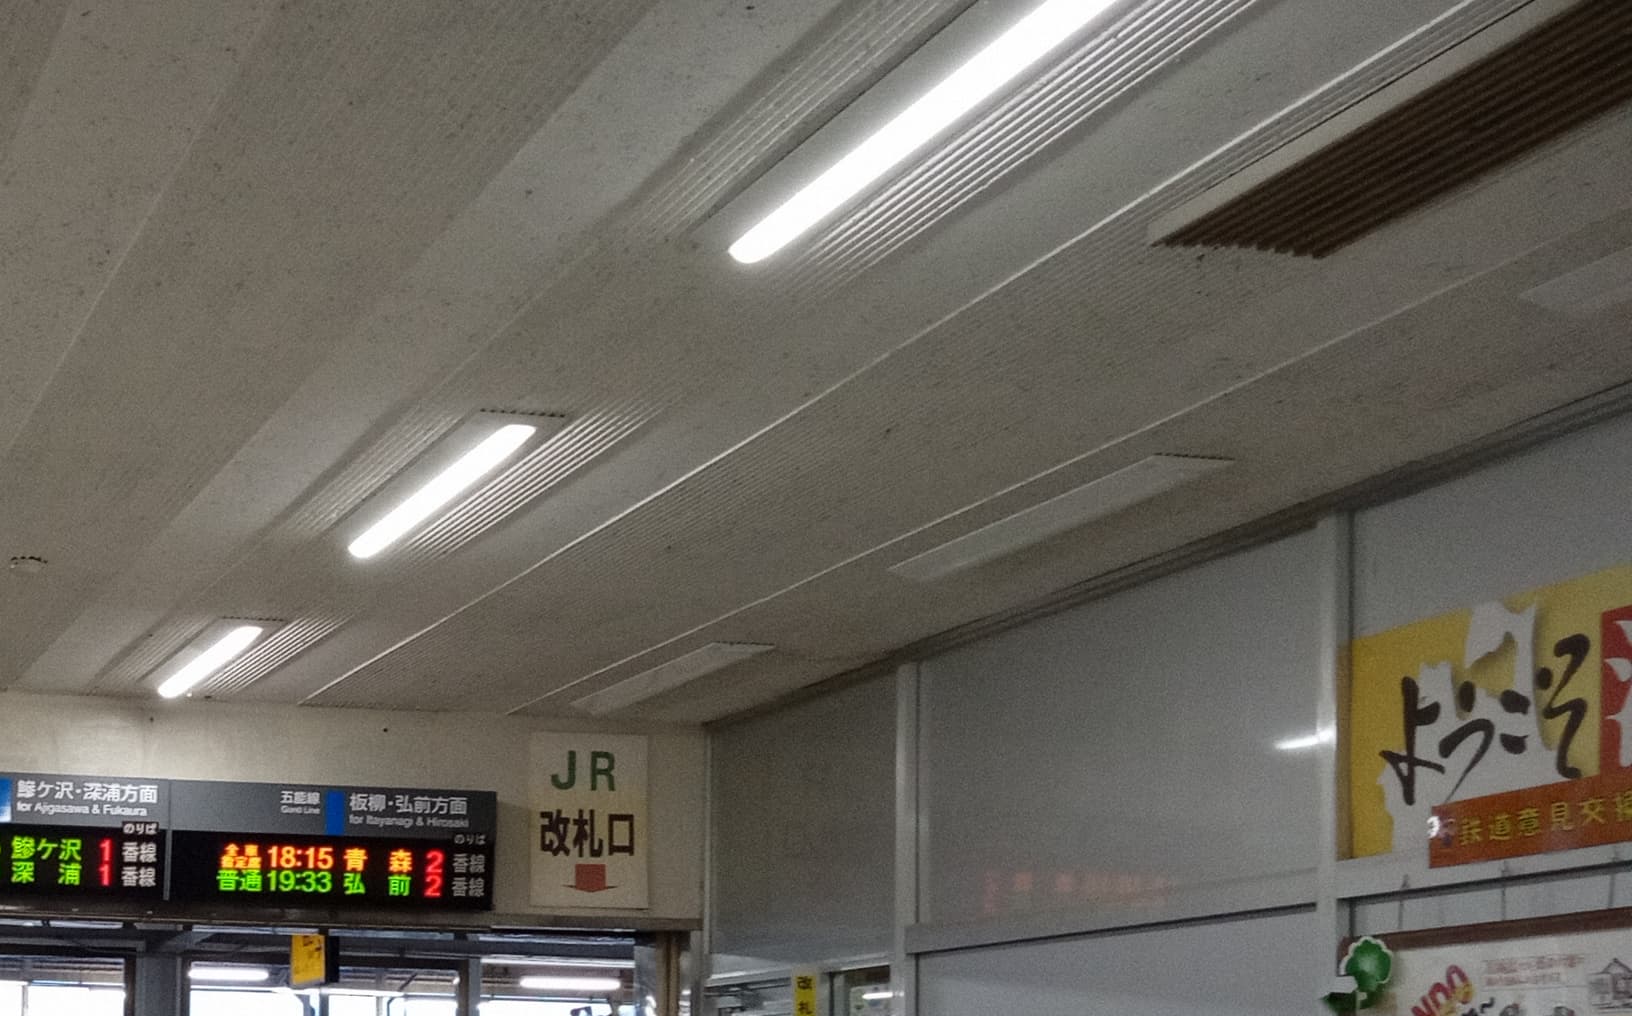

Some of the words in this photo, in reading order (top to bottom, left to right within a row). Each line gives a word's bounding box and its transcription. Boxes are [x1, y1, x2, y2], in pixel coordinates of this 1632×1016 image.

[17, 802, 32, 812] for
[123, 823, 157, 834] のりば
[350, 815, 363, 825] for
[540, 809, 634, 857] 改札口
[100, 838, 111, 861] 1
[268, 846, 334, 869] 18:15
[425, 851, 445, 874] 2
[100, 864, 111, 886] 1
[216, 869, 262, 891] 普通
[268, 870, 332, 892] 19:33
[424, 874, 443, 897] 2
